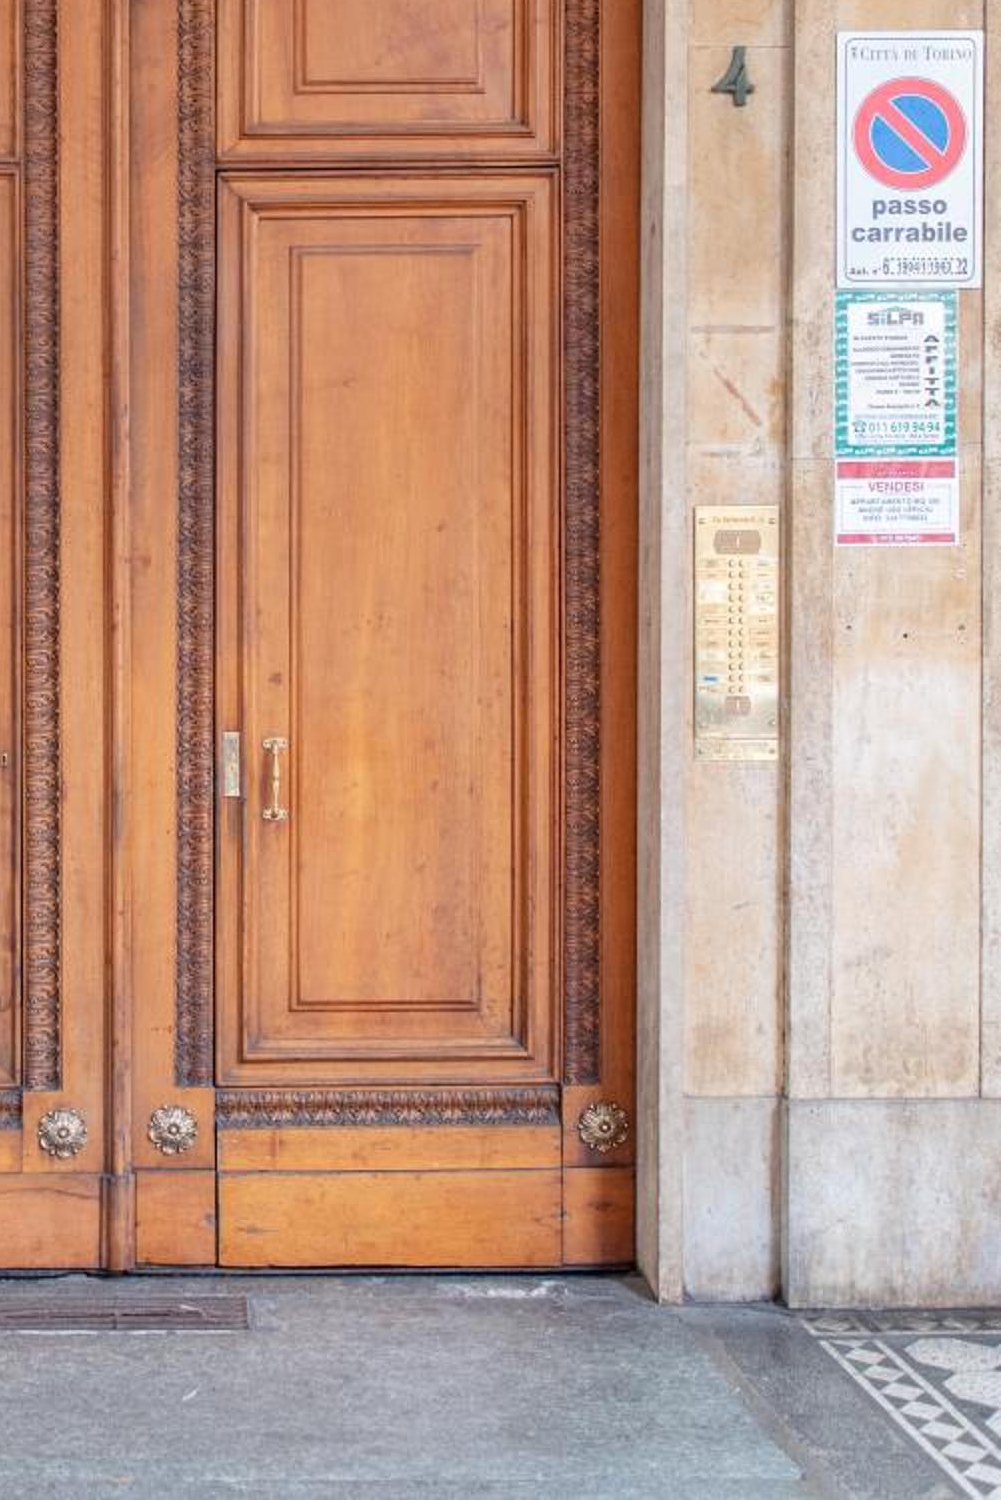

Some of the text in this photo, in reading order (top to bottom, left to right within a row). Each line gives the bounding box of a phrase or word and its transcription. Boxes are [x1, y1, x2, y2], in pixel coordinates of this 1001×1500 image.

[872, 198, 948, 219] passo
[851, 222, 968, 243] carrabile
[868, 481, 924, 493] VENDESI
